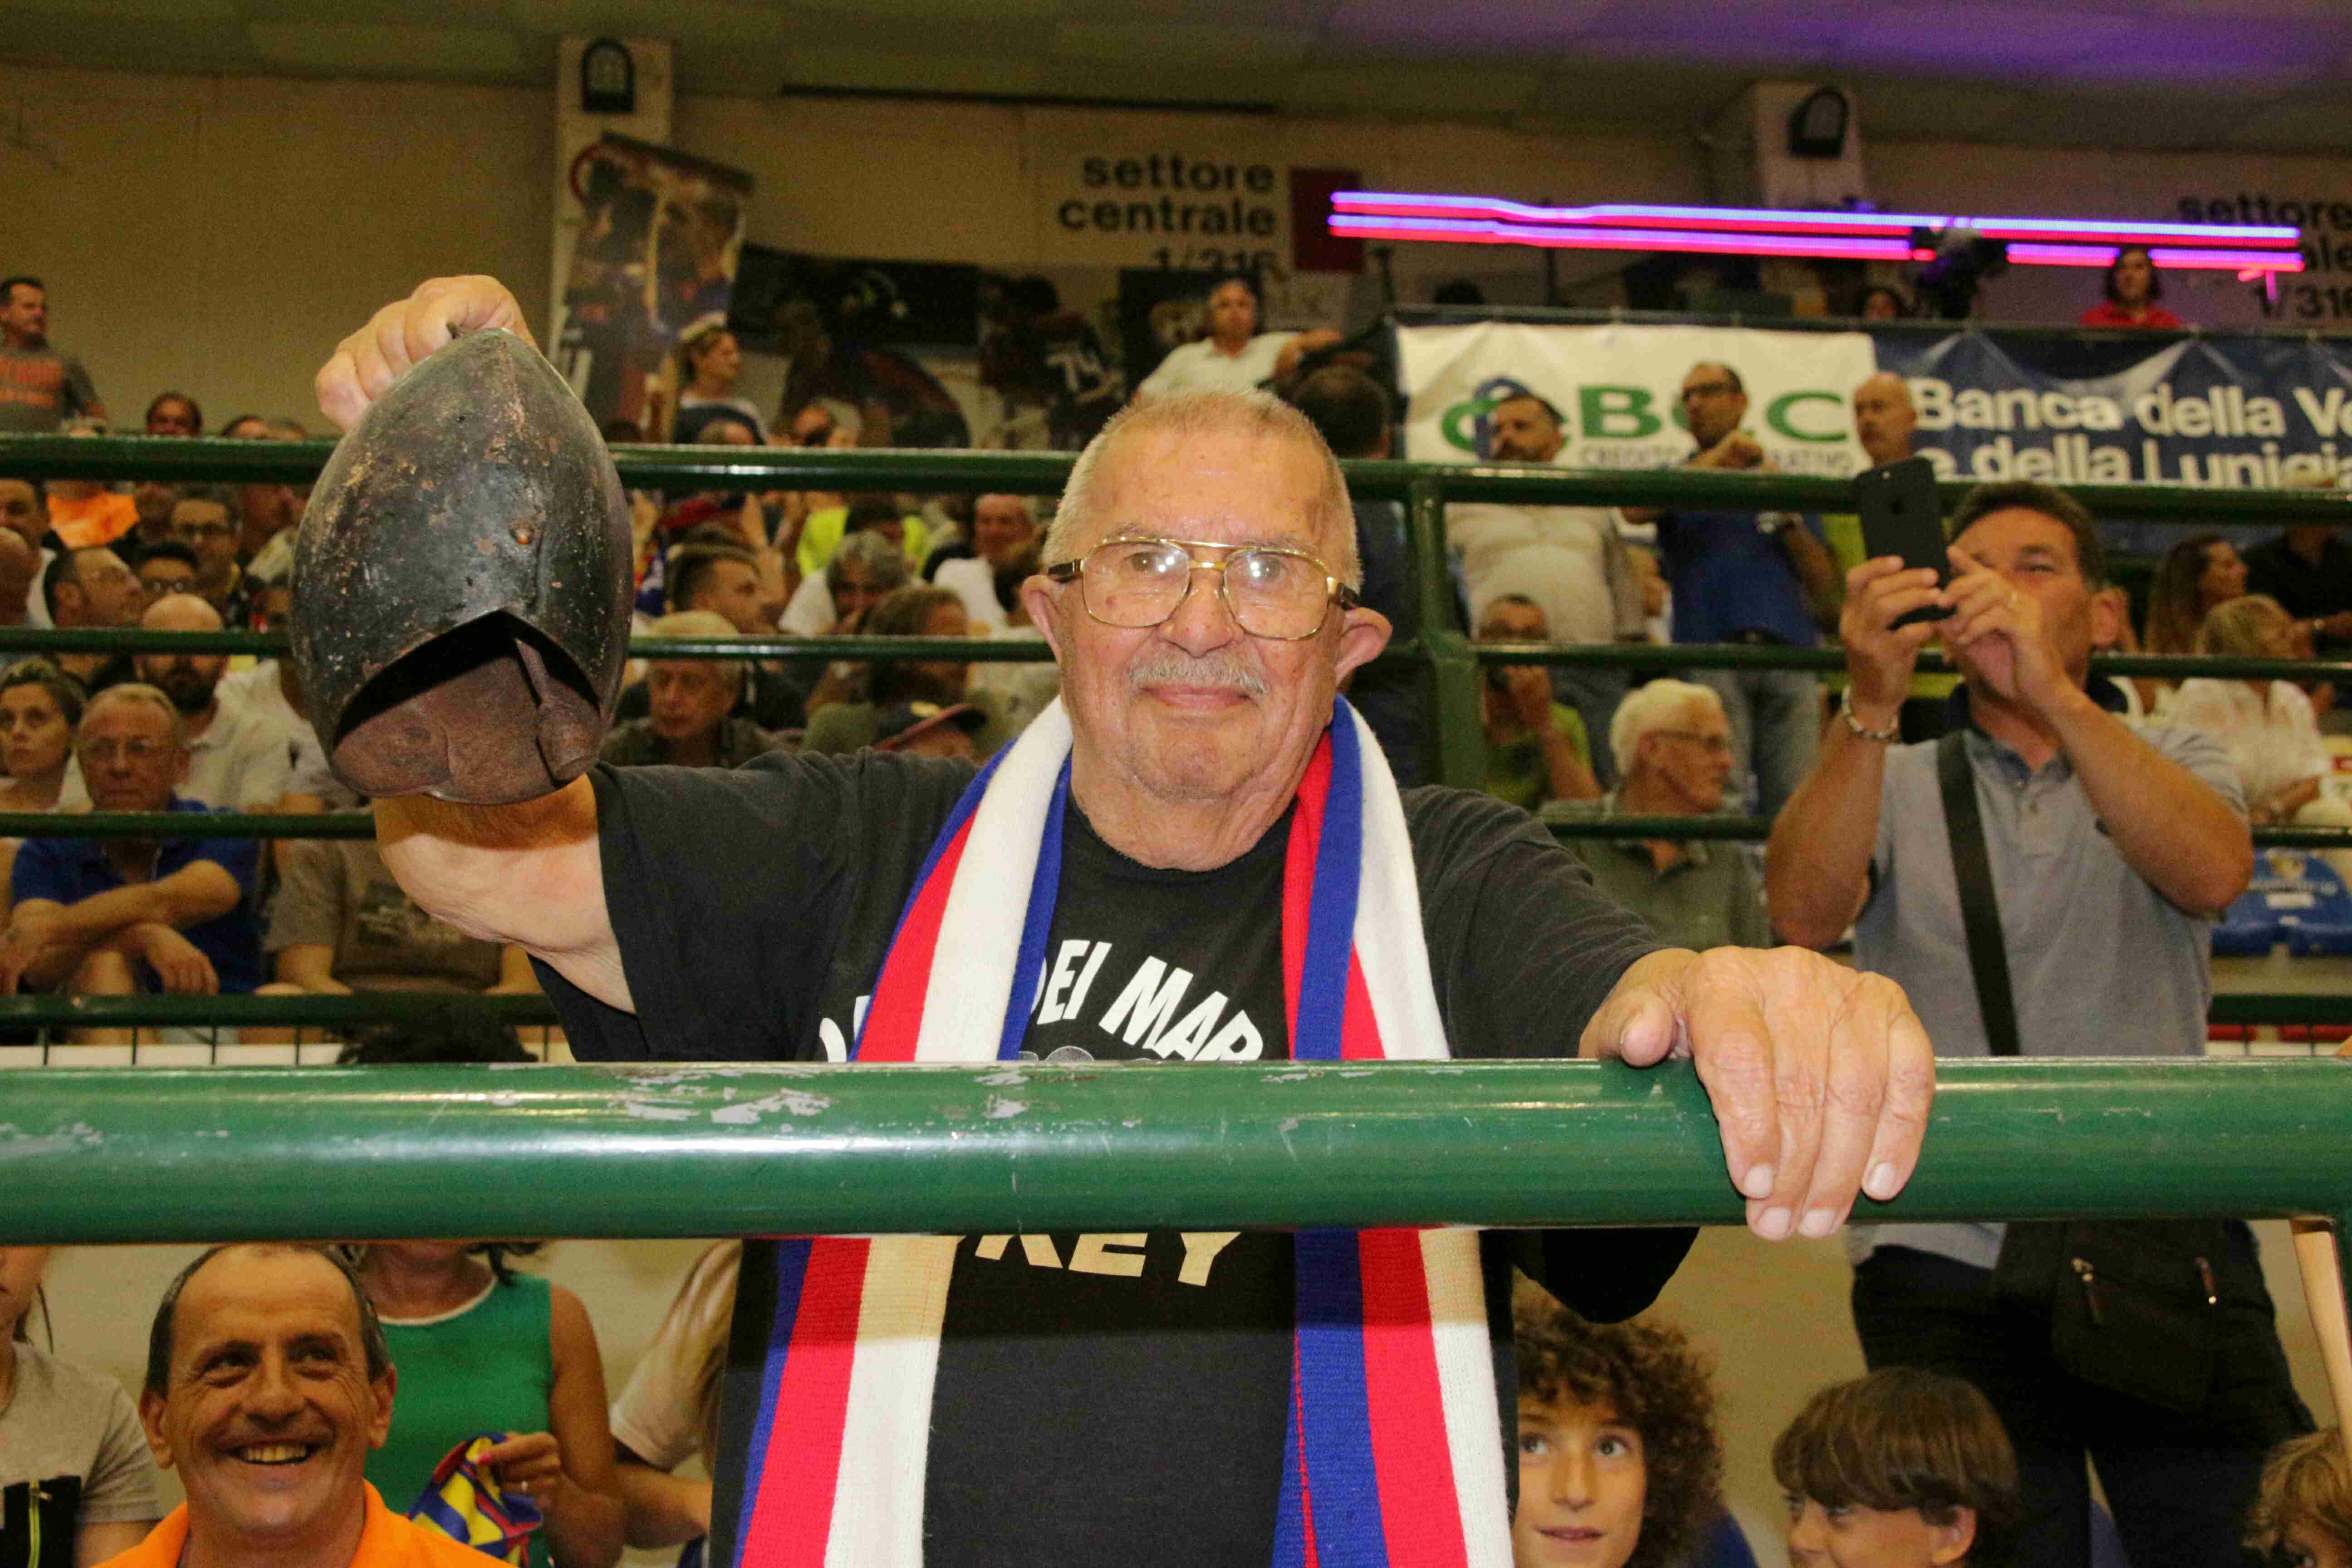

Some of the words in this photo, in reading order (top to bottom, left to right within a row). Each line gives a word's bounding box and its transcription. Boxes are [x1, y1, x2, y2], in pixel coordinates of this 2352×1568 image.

[1083, 153, 1275, 192] settore
[1059, 196, 1275, 236] centrale
[1908, 377, 2124, 430] Banca
[2134, 383, 2287, 437] della
[1970, 435, 2130, 483] della
